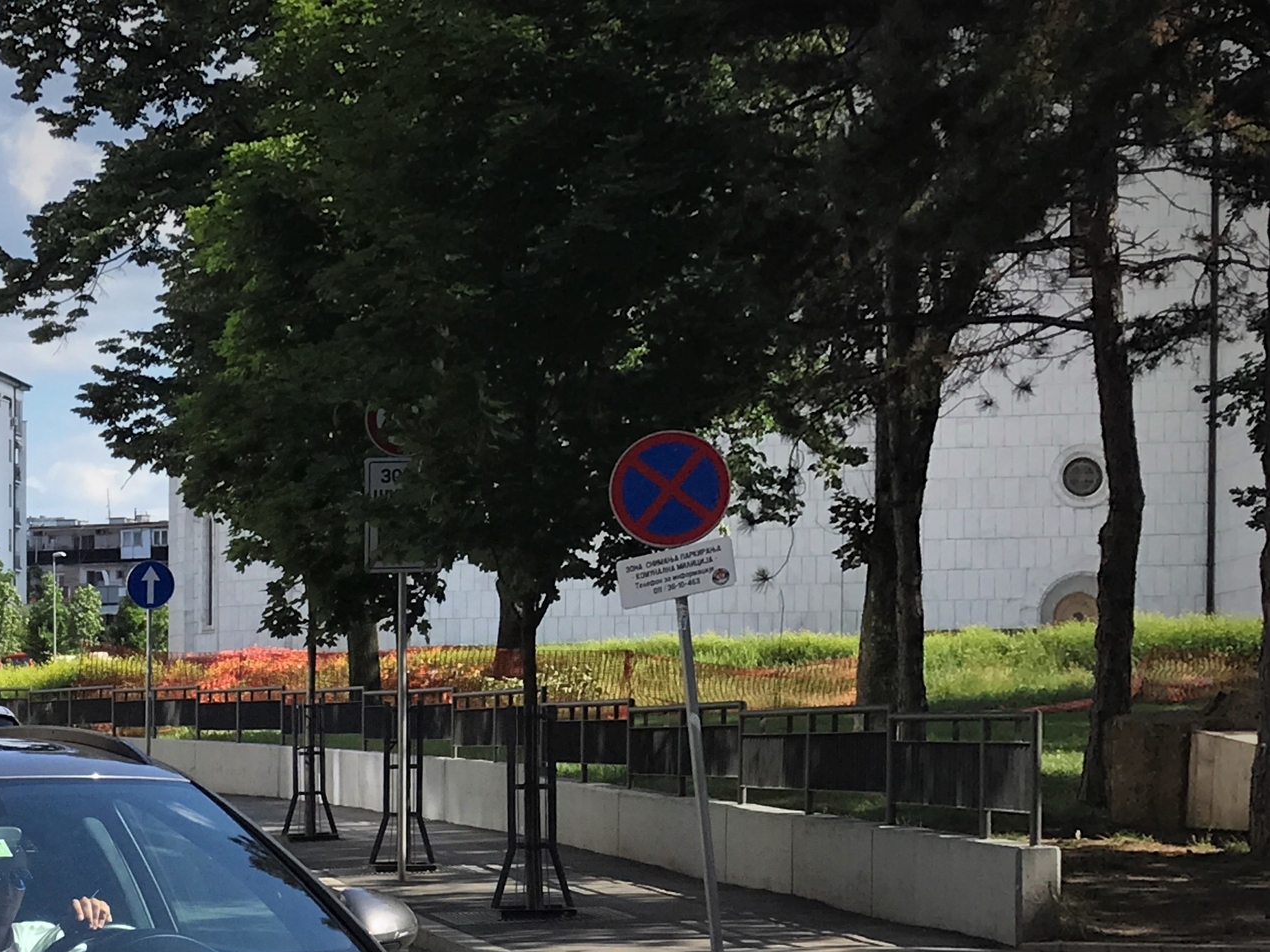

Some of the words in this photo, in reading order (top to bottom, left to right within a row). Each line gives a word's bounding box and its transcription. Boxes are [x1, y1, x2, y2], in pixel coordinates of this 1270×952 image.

[626, 563, 642, 574] ЗОНА
[680, 545, 722, 561] ПАРКИРАЊА
[636, 566, 675, 580] КОМУНАЛНА
